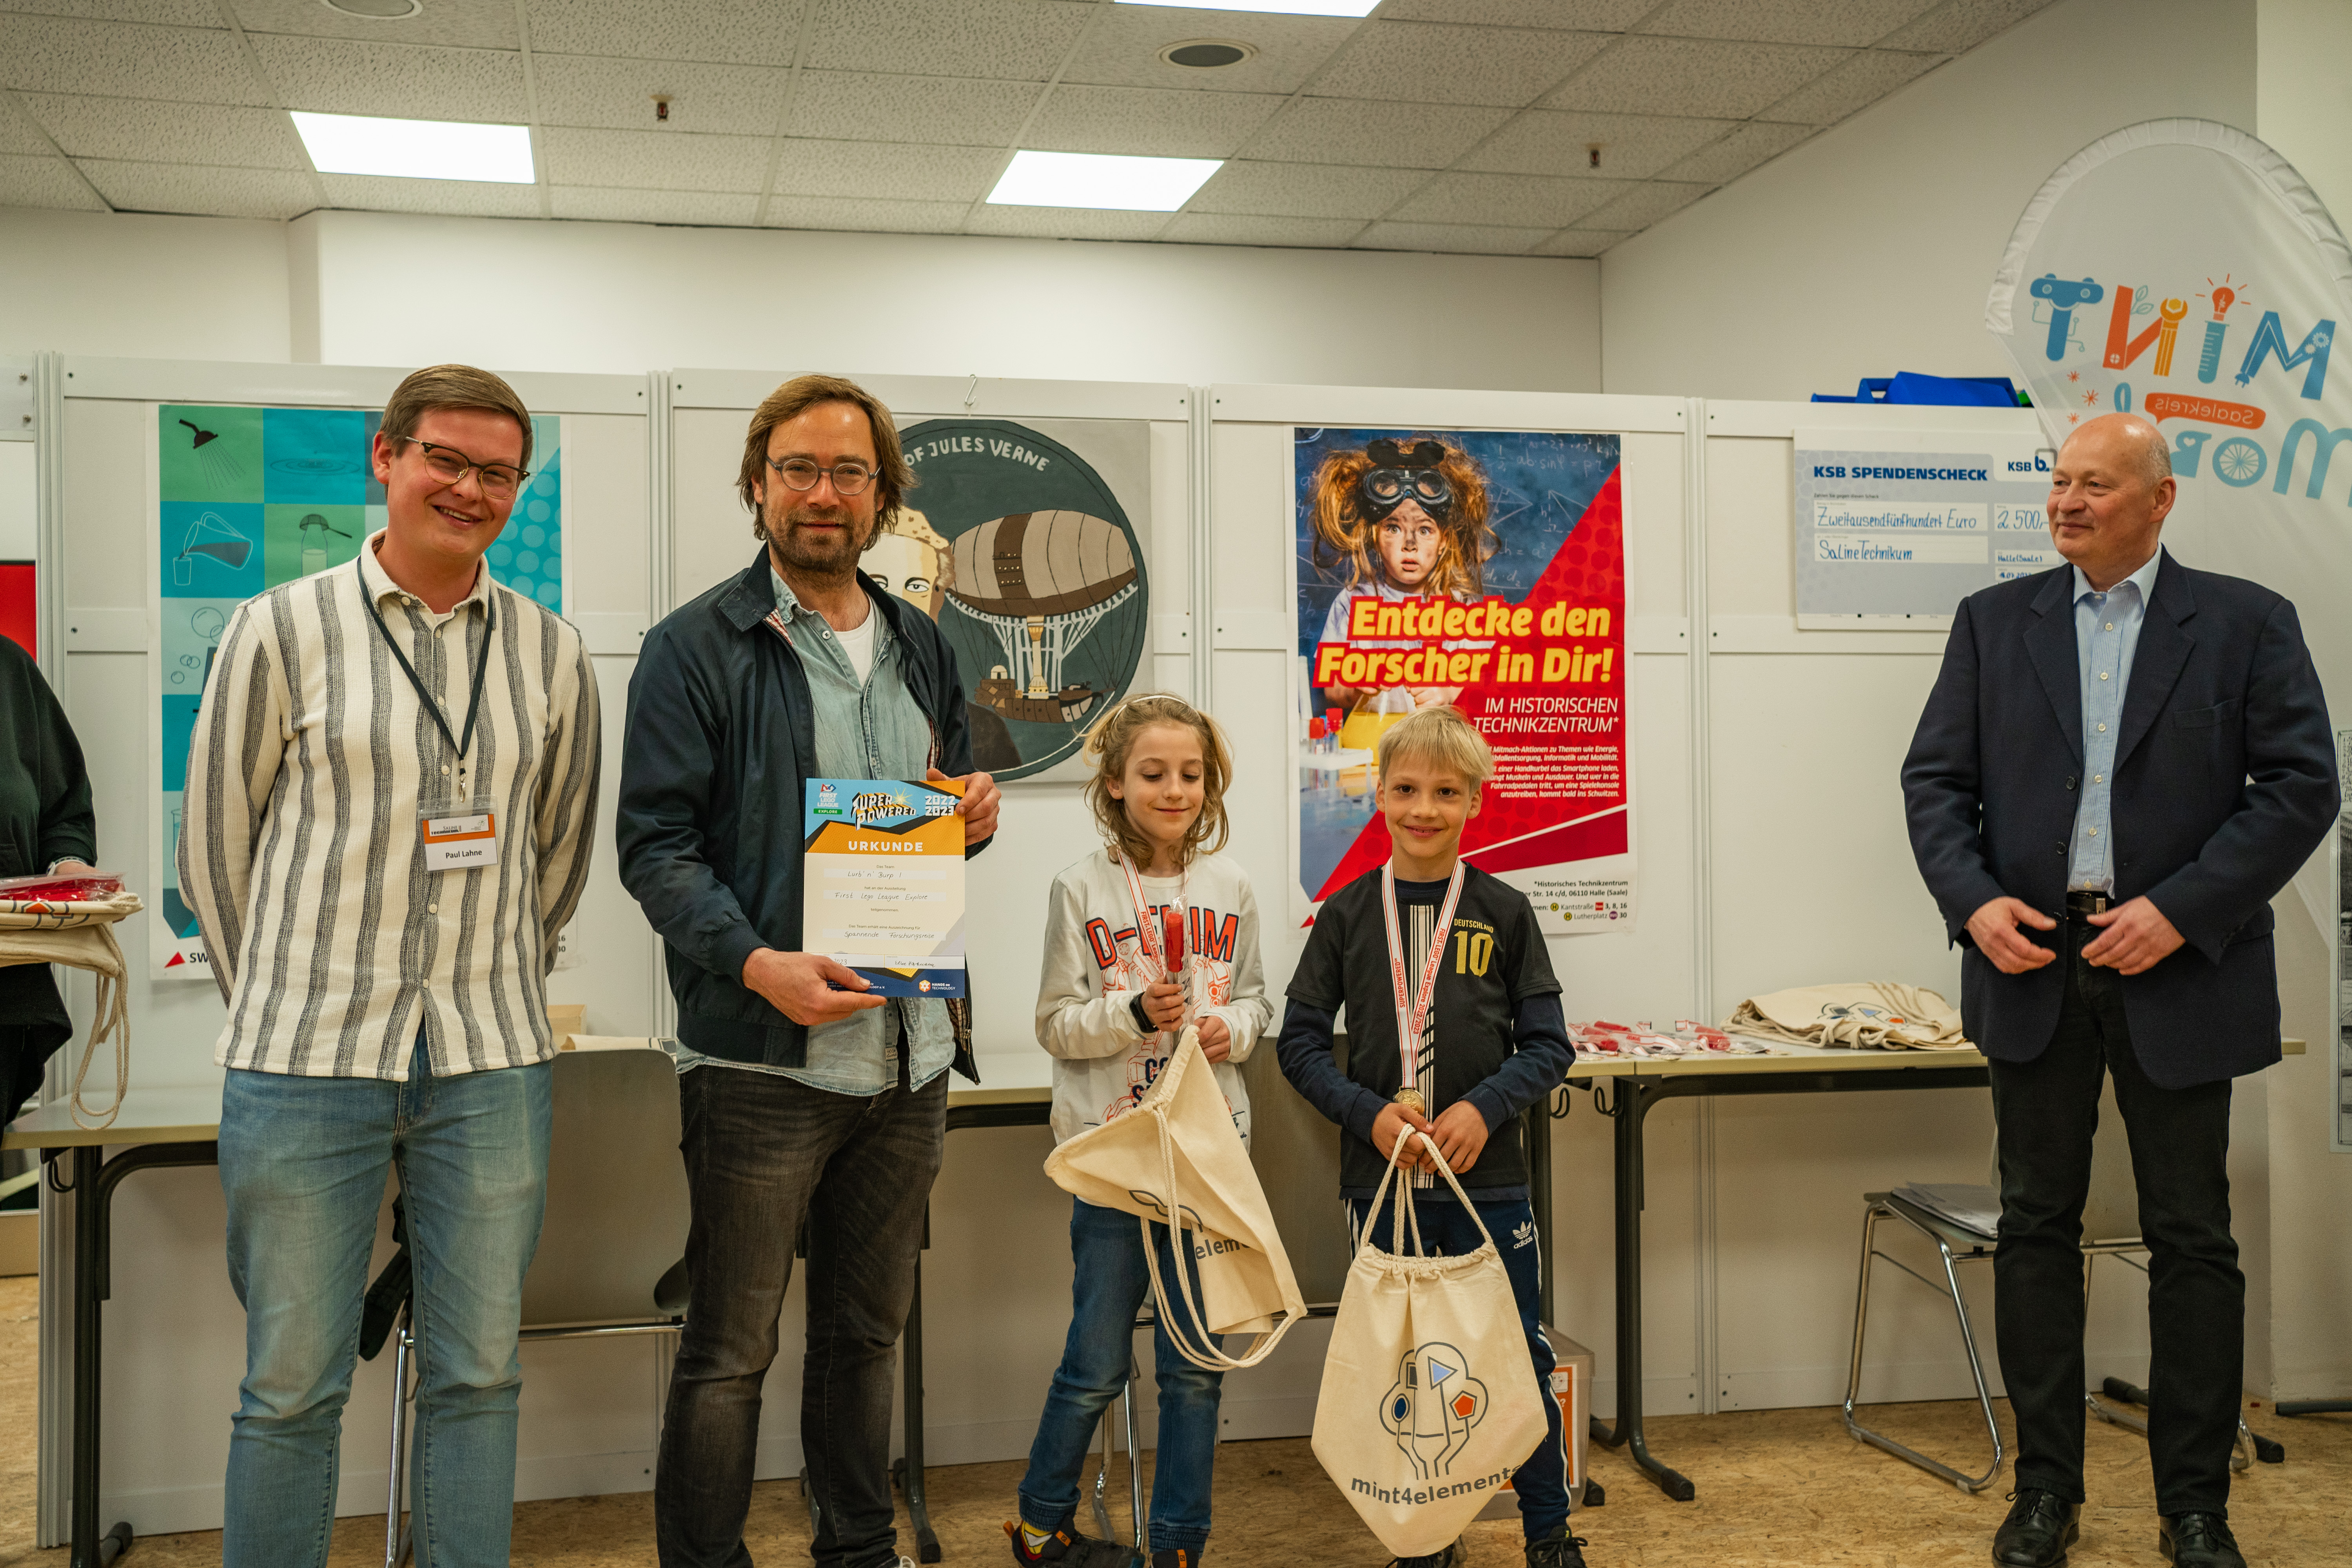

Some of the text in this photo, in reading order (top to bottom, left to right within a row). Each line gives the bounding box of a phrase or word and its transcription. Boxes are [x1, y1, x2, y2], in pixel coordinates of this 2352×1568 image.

[904, 437, 1049, 471] OF JULES VERNE
[1814, 466, 1987, 481] KSB SPENDENSCHECK
[2008, 461, 2032, 471] KSB
[1947, 509, 1976, 528] Euro
[1352, 601, 1611, 637] Entdecke den
[1318, 646, 1613, 682] Forscher in Dir!
[1485, 697, 1618, 713] IM HISTORISCHEN
[1595, 745, 1618, 753] Energie,
[1579, 781, 1619, 789] Spielekonsole
[851, 792, 893, 818] SUPER
[925, 795, 956, 805] 2022
[856, 806, 916, 831] POWERED
[925, 806, 955, 816] 2023
[848, 841, 923, 852] URKUNDE
[878, 893, 899, 902] League
[1454, 918, 1494, 933] DEUTSCHLAND
[889, 932, 935, 940] Forschungsreise
[190, 953, 208, 963] SW
[1454, 931, 1494, 977] 10
[1426, 960, 1437, 980] League
[1421, 982, 1431, 1002] Explore
[1413, 1004, 1425, 1034] 2022/2023
[1195, 1238, 1251, 1259] elem
[1514, 1236, 1533, 1249] adidas
